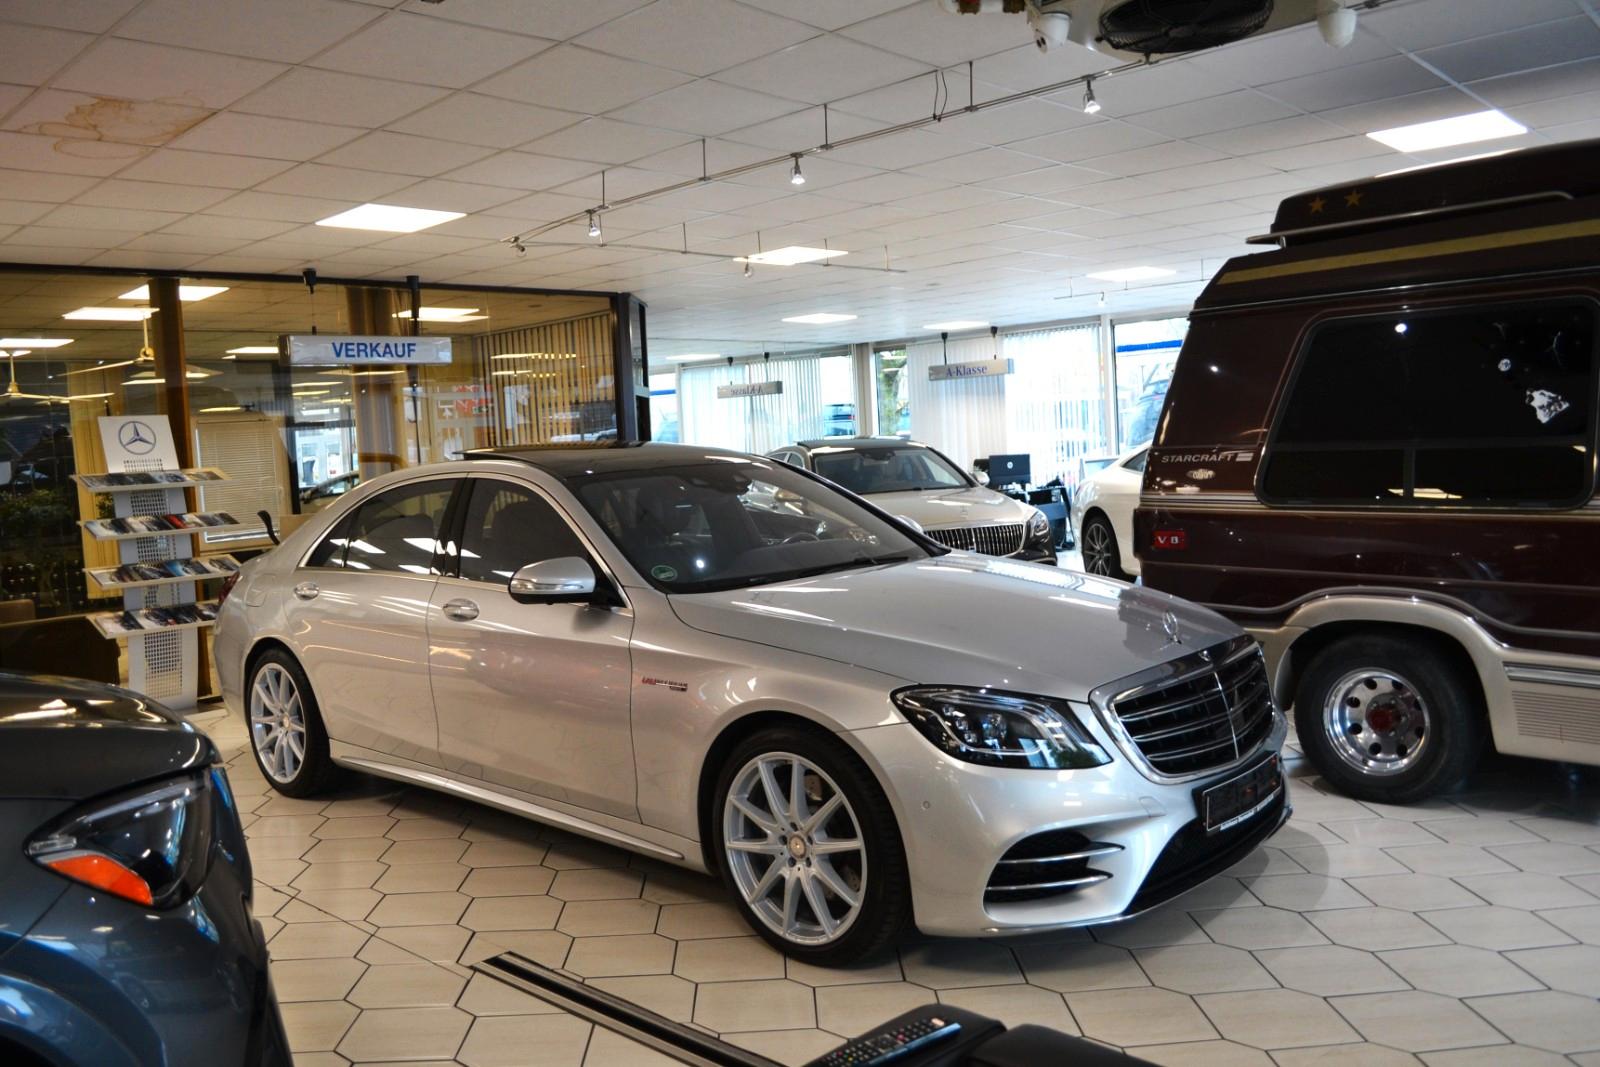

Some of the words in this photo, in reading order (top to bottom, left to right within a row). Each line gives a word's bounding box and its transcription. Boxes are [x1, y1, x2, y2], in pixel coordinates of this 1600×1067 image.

[332, 342, 416, 358] VERKAUF
[946, 365, 988, 377] A-Klasse
[1161, 454, 1234, 463] STARCRAFT
